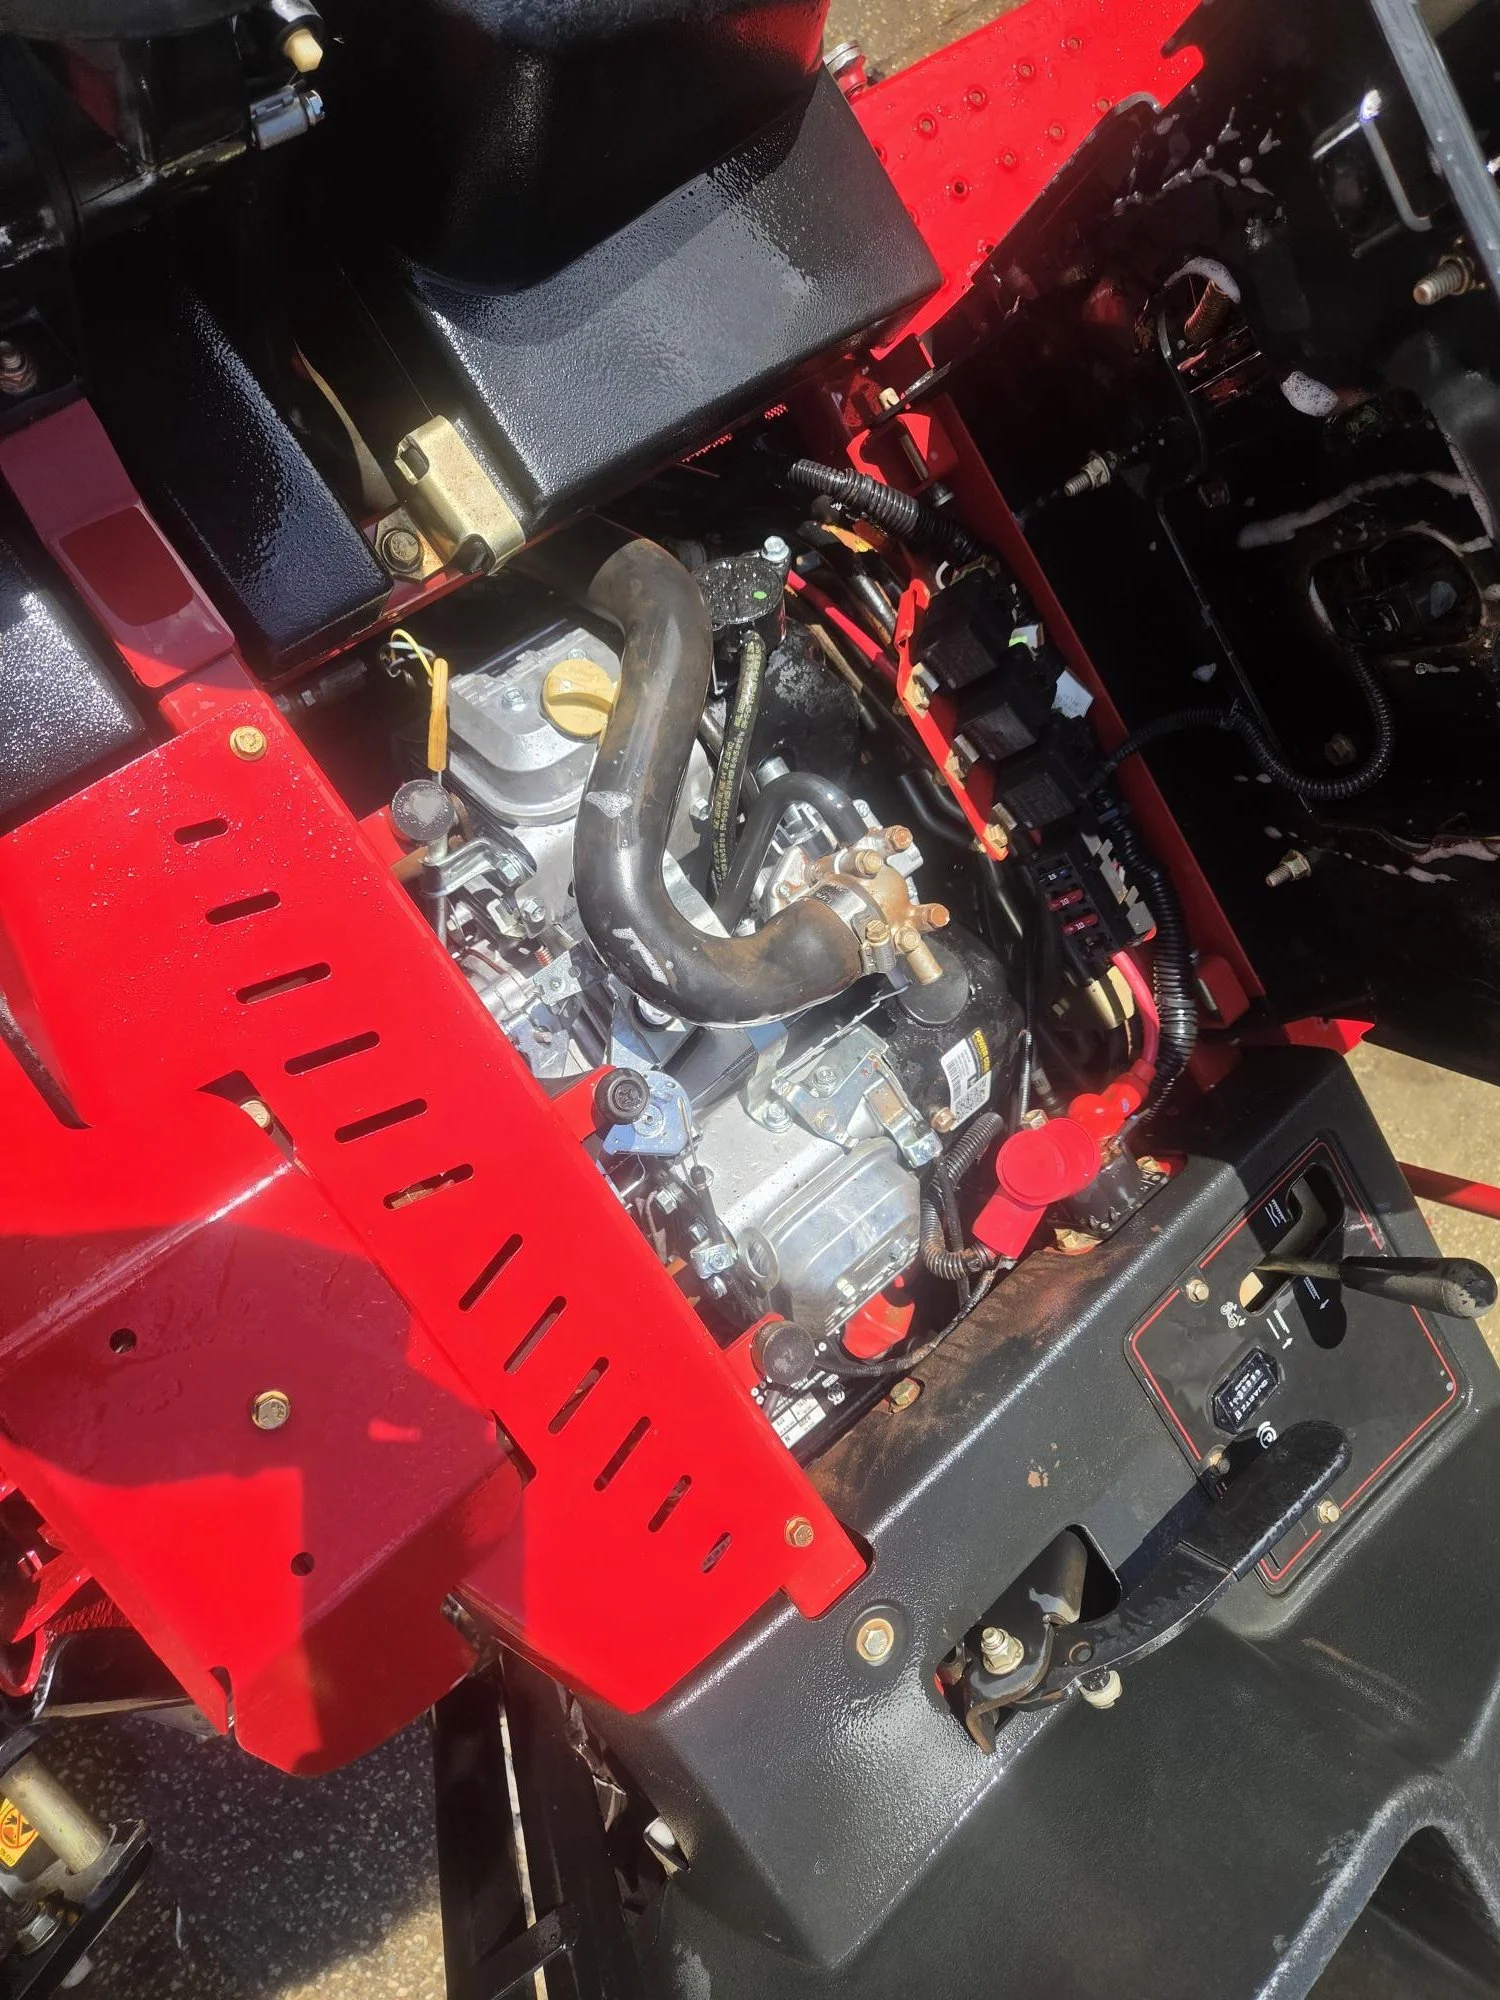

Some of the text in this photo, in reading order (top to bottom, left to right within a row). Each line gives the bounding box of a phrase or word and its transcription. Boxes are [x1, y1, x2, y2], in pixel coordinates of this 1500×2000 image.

[1060, 898, 1070, 906] 10
[1075, 922, 1085, 930] 10
[1240, 1379, 1268, 1412] QUARTZ
